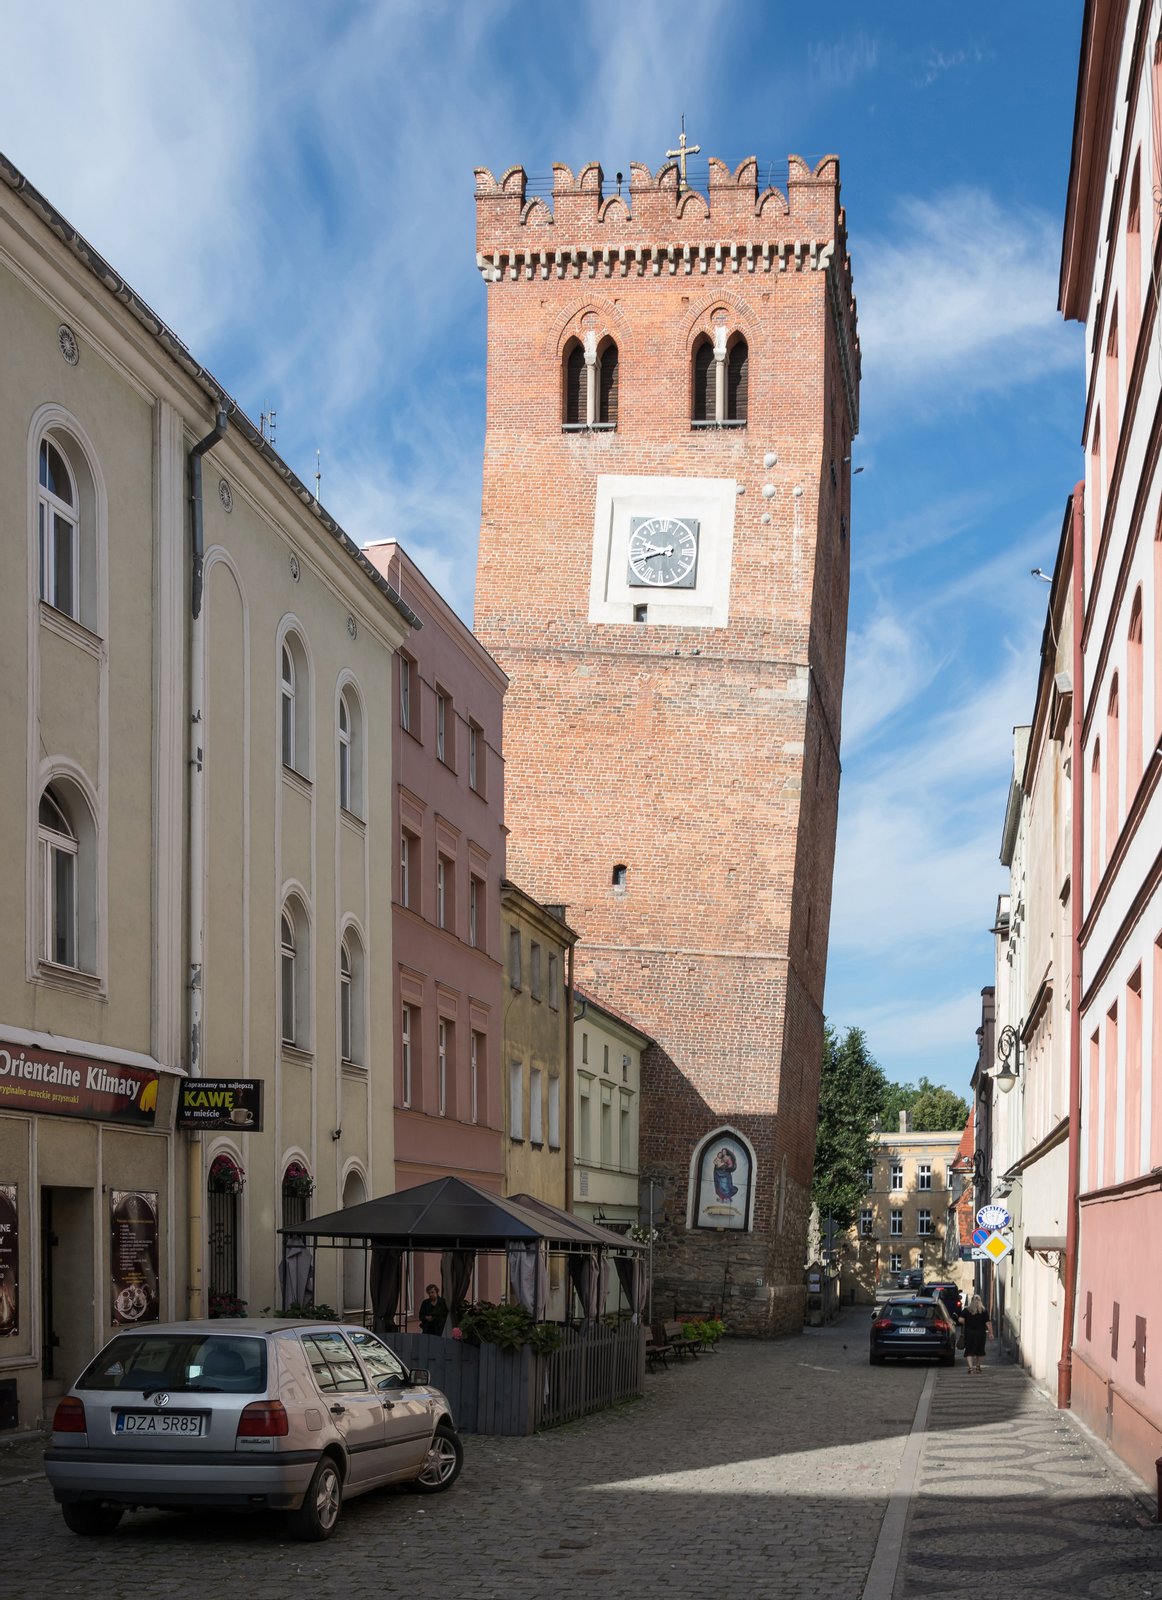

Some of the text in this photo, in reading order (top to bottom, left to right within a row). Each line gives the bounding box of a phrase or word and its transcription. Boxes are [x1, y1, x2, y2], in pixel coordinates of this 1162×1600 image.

[0, 1050, 141, 1101] Orientalne Klimaty
[184, 1081, 218, 1090] Zapraszamy
[228, 1082, 254, 1090] najlepszą
[28, 1089, 51, 1100] tureckie
[52, 1093, 80, 1104] przysmaki
[184, 1091, 234, 1111] KAWĘ
[193, 1109, 220, 1117] mieście
[126, 1416, 198, 1432] DZA 5R85
